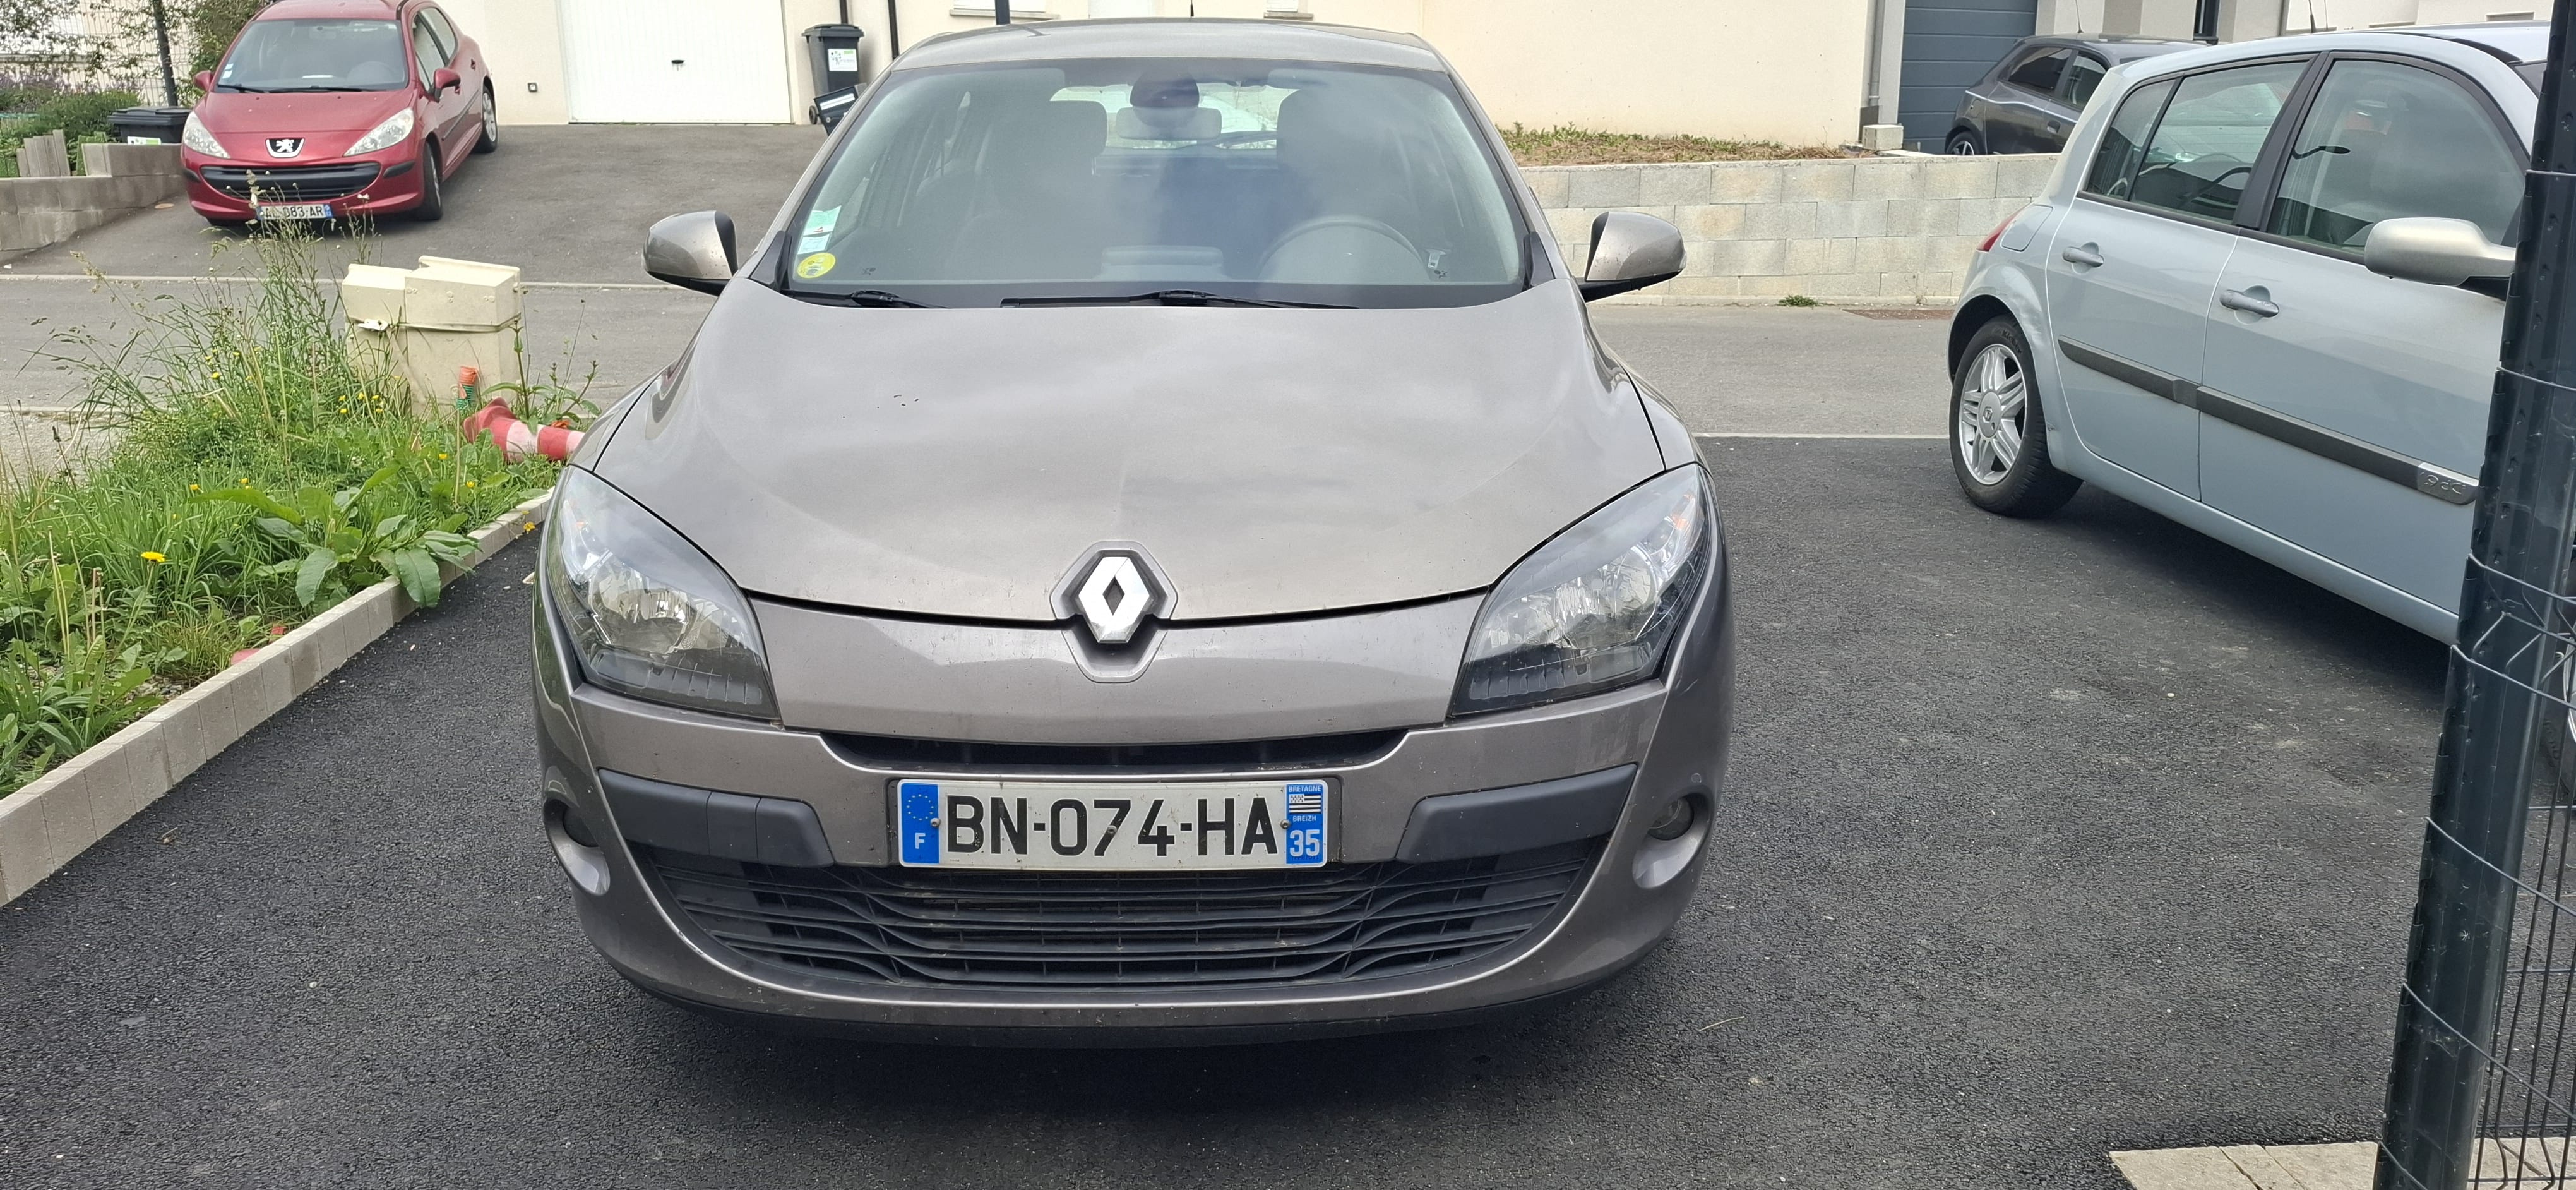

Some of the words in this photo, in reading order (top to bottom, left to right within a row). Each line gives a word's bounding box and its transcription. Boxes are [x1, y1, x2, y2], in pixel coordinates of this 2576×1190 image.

[946, 794, 1279, 856] BN-074-HA
[915, 832, 926, 849] F
[1289, 829, 1320, 857] 35
